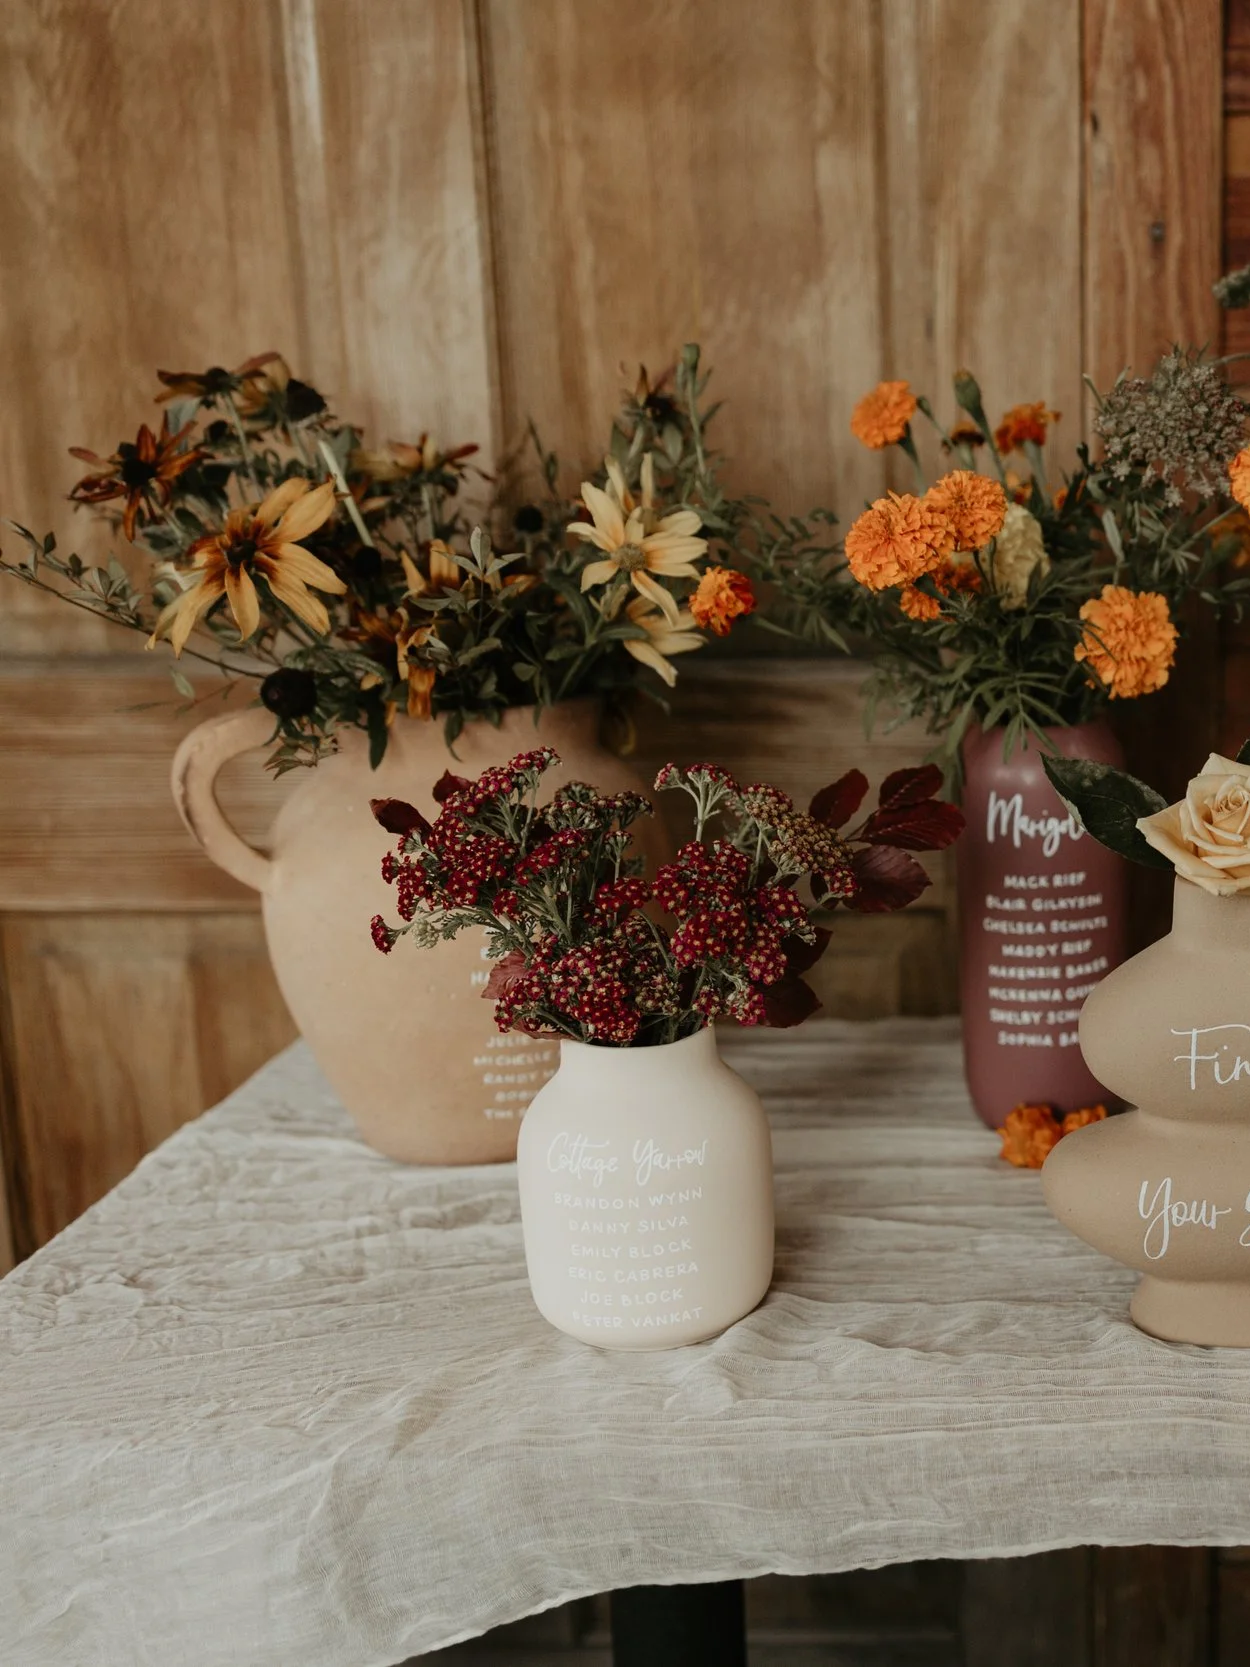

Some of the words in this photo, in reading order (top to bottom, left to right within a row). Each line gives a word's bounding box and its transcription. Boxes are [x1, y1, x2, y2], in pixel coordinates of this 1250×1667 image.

[986, 790, 1087, 858] Marigol
[1004, 875, 1049, 889] MACK
[983, 917, 1045, 935] CHELSEA
[1002, 944, 1058, 957] MADDY
[547, 1131, 619, 1187] Cottage
[632, 1138, 709, 1186] Yarrow
[553, 1191, 640, 1210] BRANDON
[649, 1187, 703, 1207] WYNN
[568, 1218, 631, 1234] DANNY
[636, 1215, 690, 1234] SILVA
[1138, 1177, 1232, 1260] Your
[571, 1244, 622, 1259] EMILY
[628, 1238, 693, 1259] BLOCK
[568, 1266, 608, 1283] ERIC
[613, 1261, 700, 1284] CABRERA
[580, 1289, 613, 1307] JOE
[621, 1287, 684, 1307] BLOCK
[572, 1310, 624, 1329] PETER
[630, 1306, 704, 1328] VANKAT
